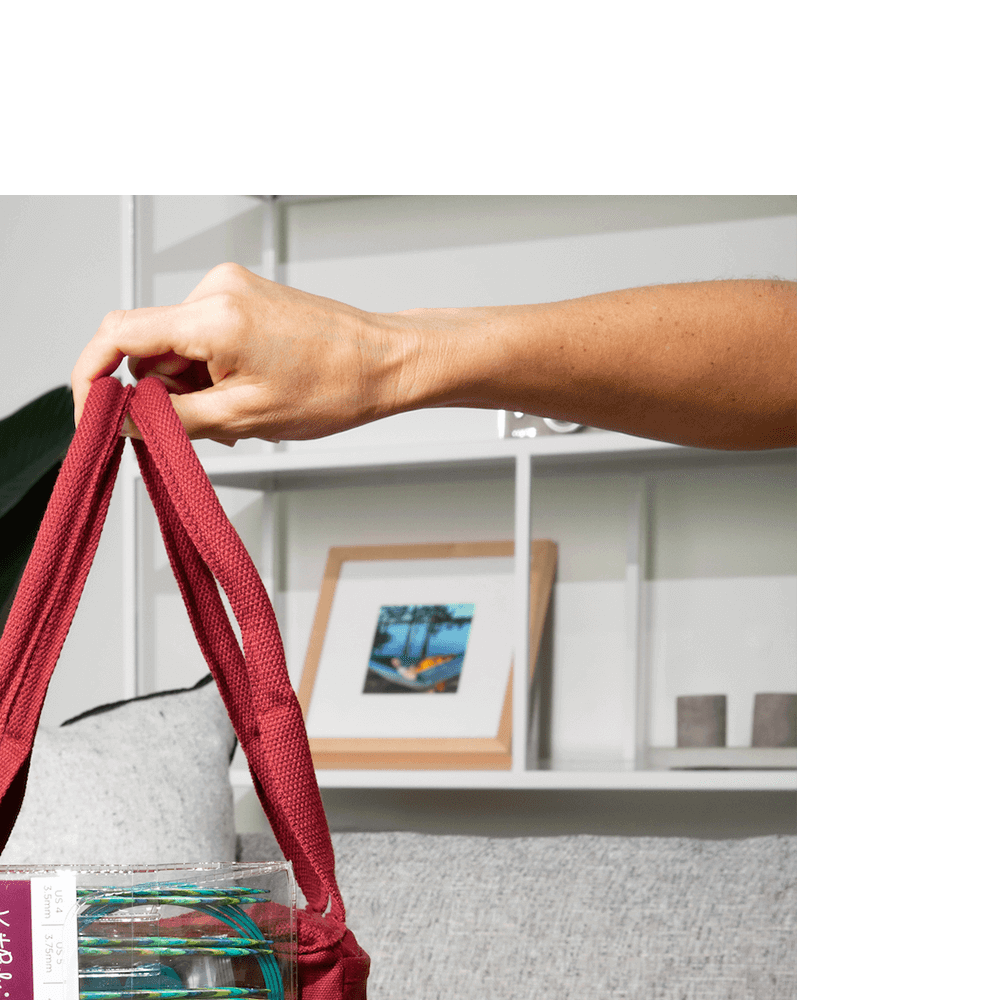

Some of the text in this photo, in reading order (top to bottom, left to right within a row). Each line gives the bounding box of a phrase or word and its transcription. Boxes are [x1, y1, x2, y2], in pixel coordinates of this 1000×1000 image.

[43, 885, 52, 919] 3.5mm
[55, 889, 63, 904] US
[44, 934, 54, 973] 3.75mm
